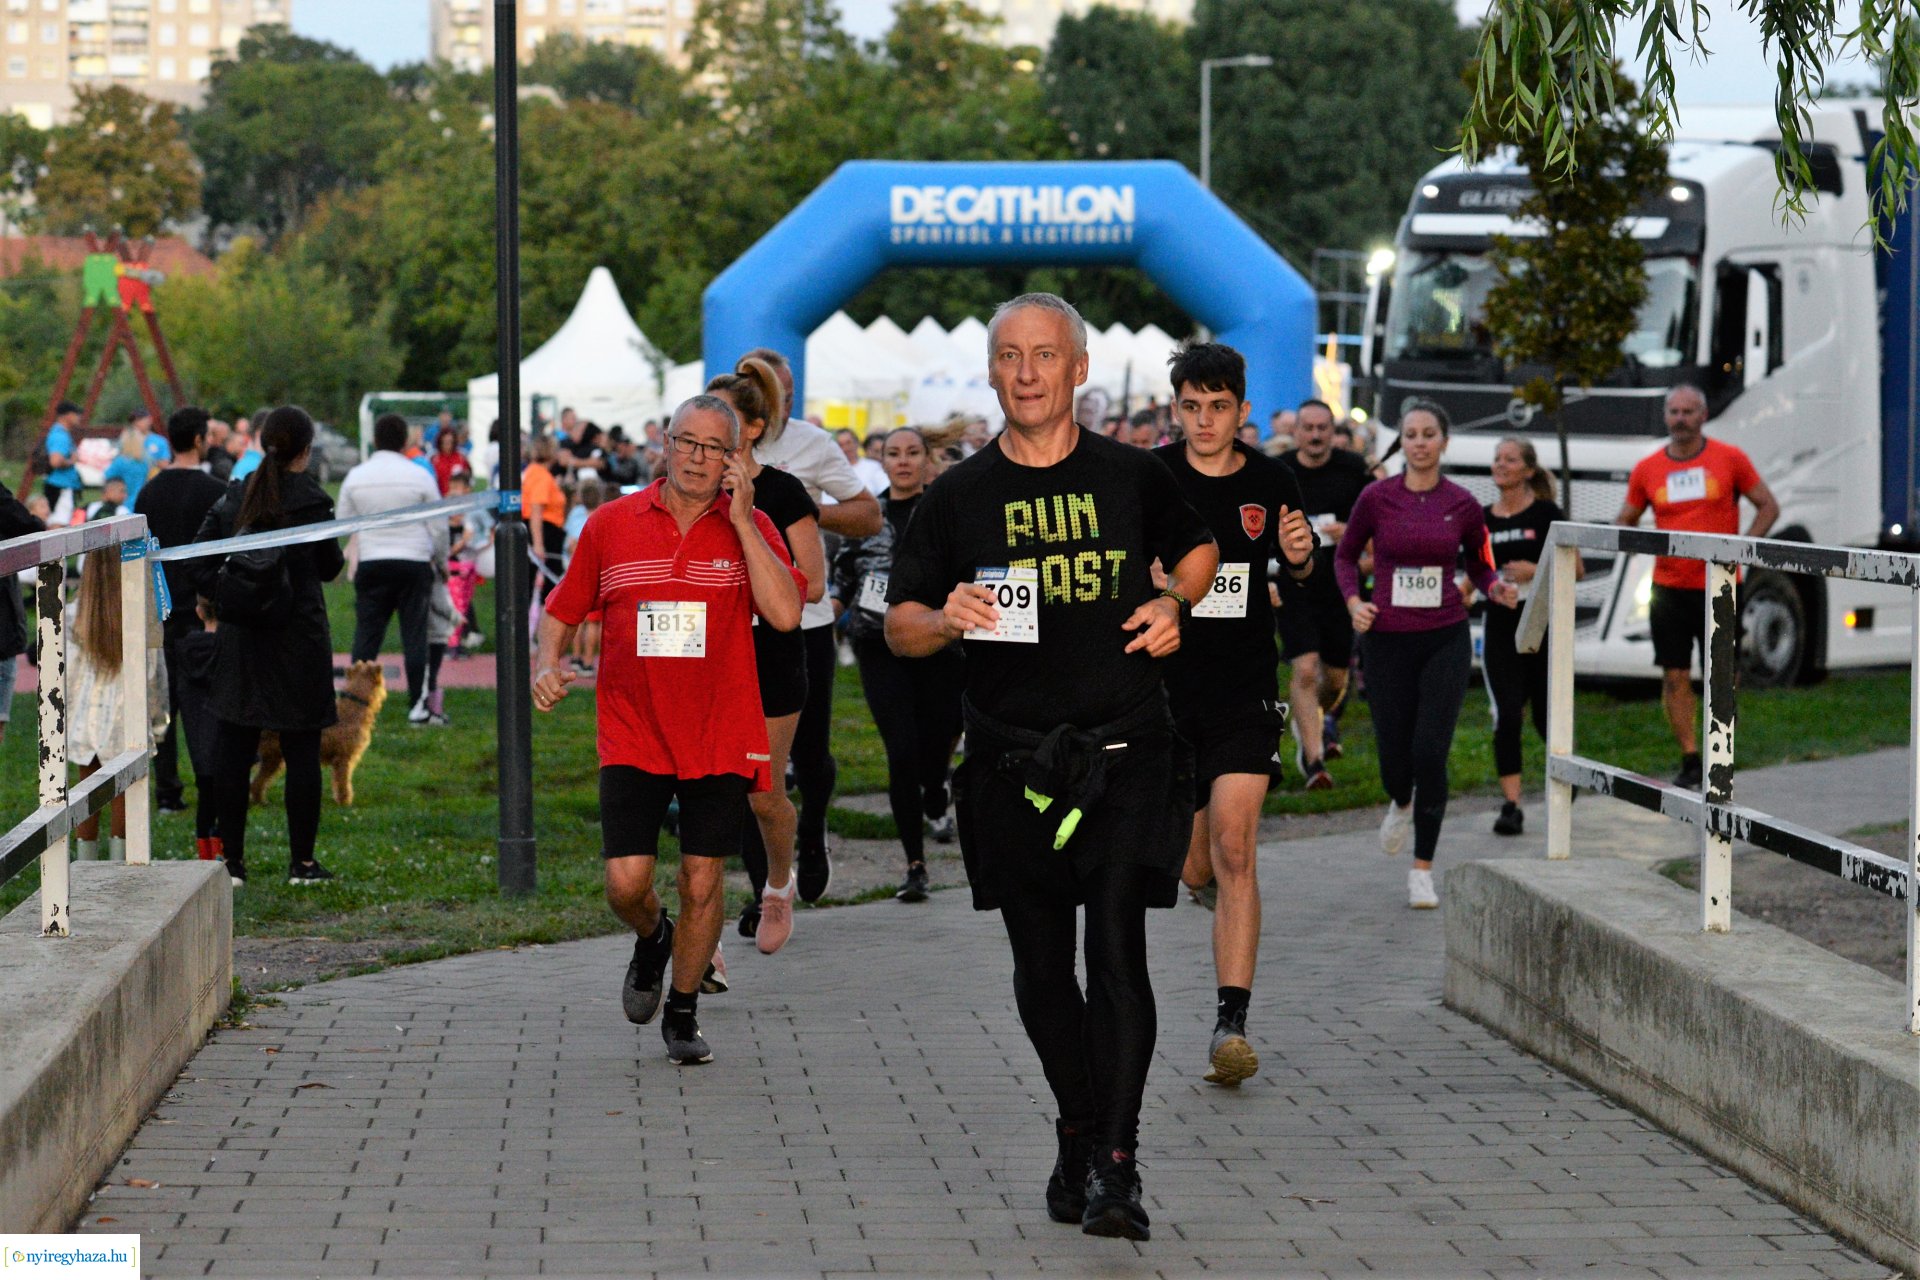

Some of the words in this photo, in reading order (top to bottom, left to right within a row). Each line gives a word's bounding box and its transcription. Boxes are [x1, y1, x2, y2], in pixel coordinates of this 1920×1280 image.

[890, 185, 1135, 224] DECATHLON
[1002, 227, 1014, 244] A
[1005, 493, 1100, 547] RUN
[870, 579, 886, 594] 13
[1009, 550, 1127, 605] AST
[1213, 576, 1242, 594] 86
[1398, 576, 1437, 589] 1380
[983, 583, 1031, 609] 309
[647, 613, 696, 632] 1813
